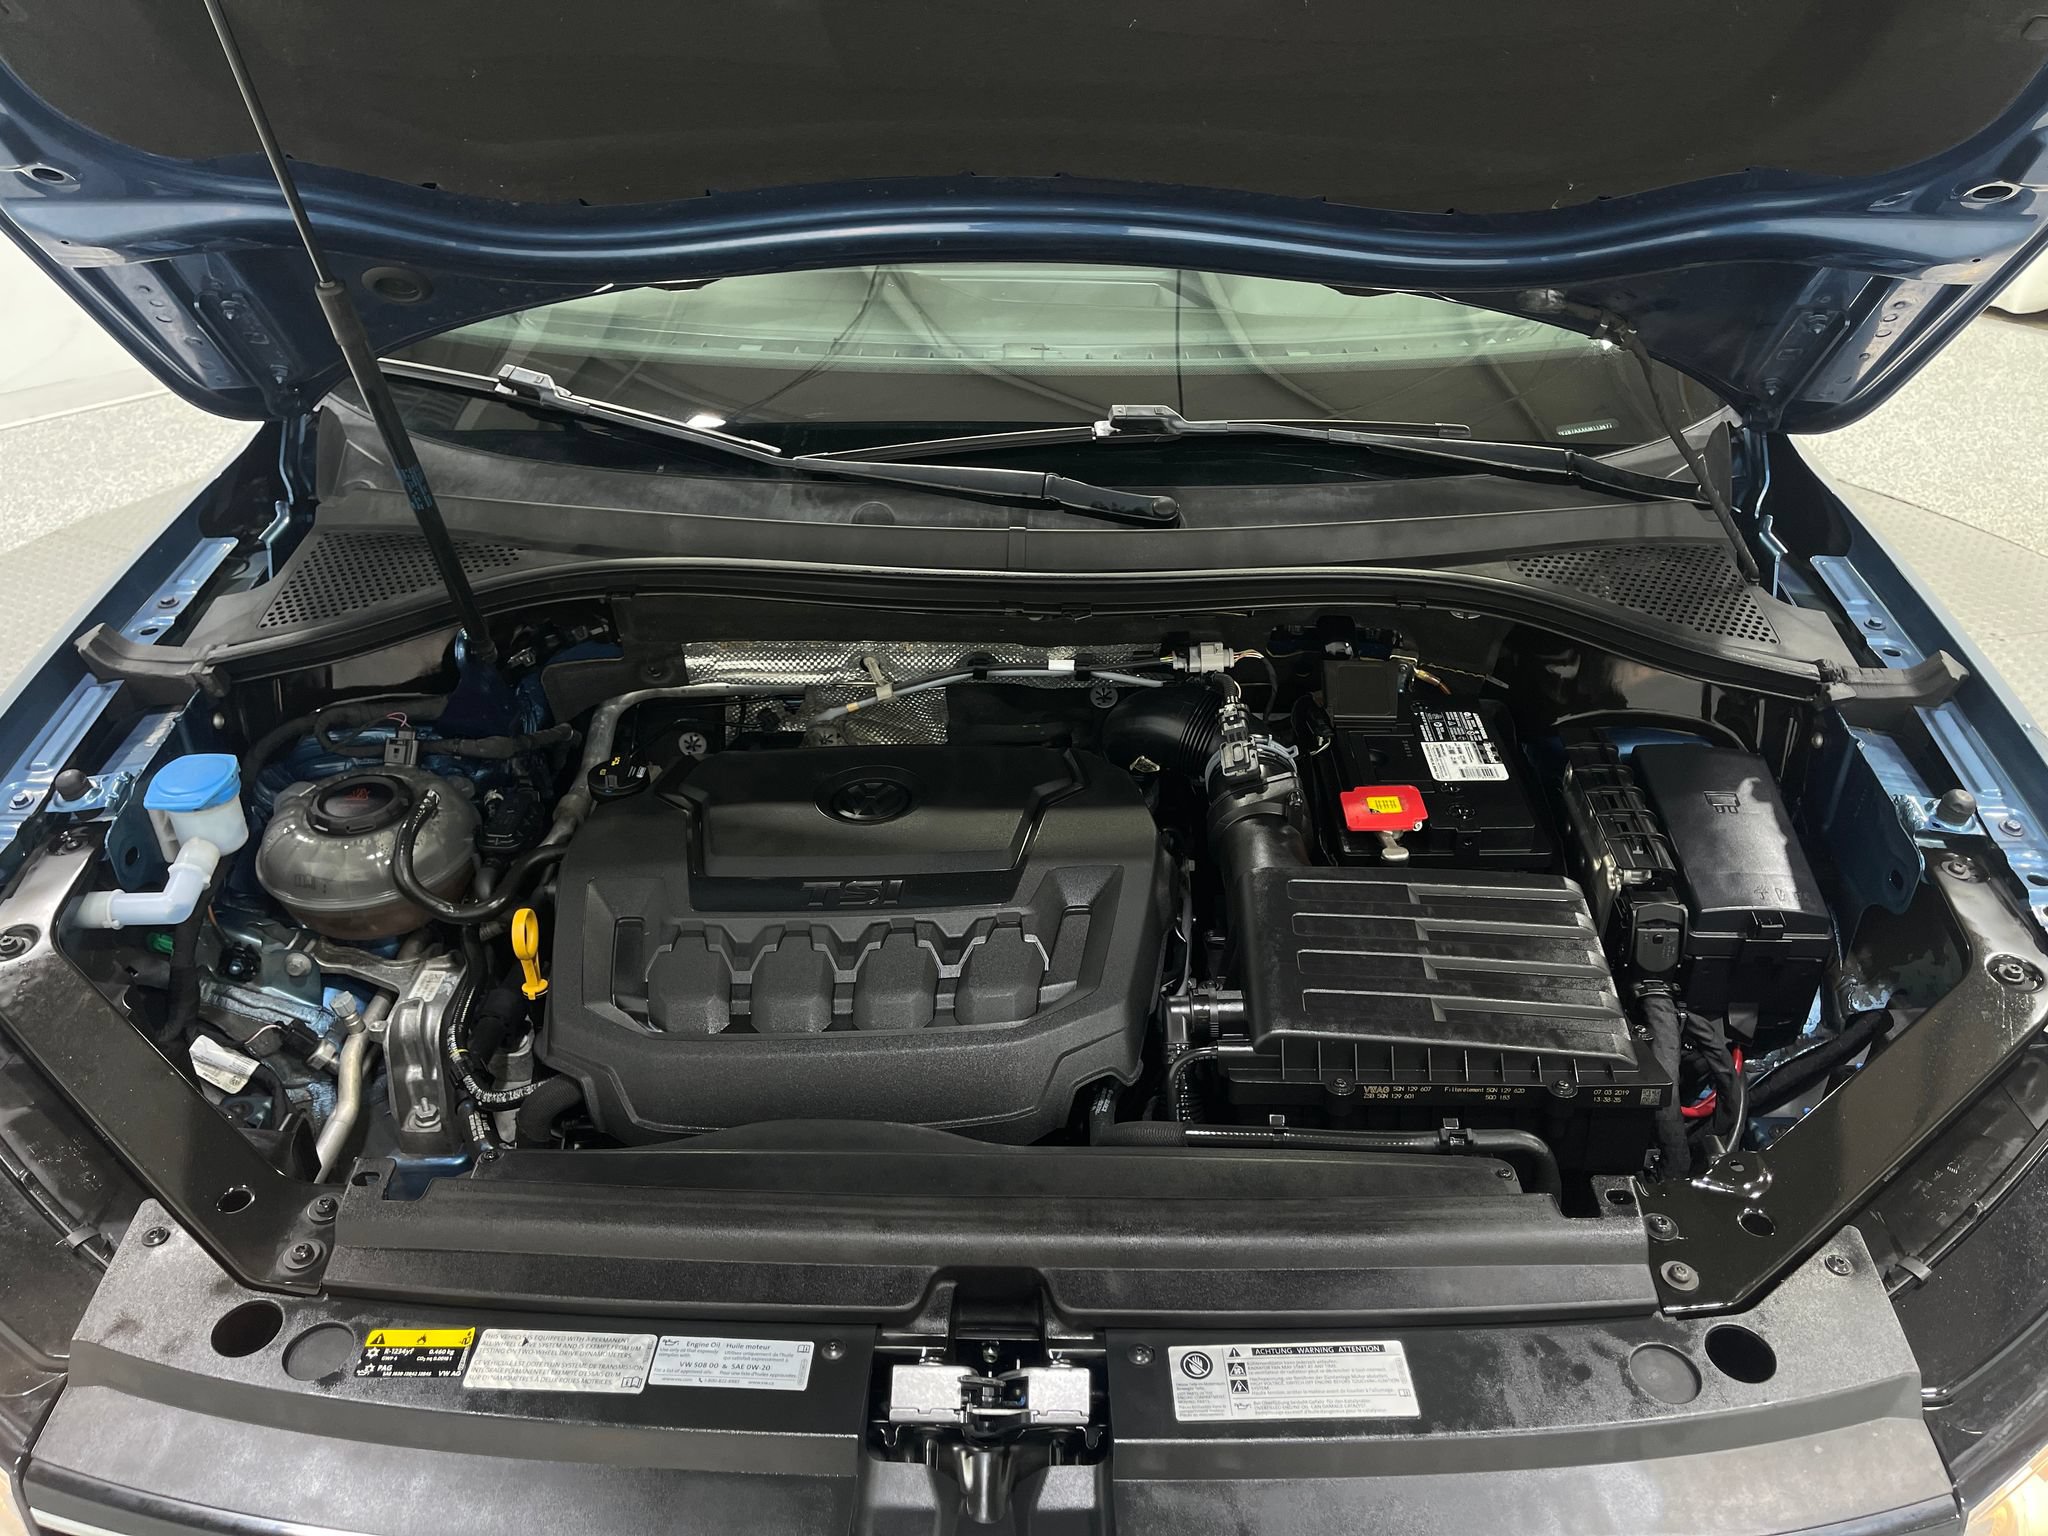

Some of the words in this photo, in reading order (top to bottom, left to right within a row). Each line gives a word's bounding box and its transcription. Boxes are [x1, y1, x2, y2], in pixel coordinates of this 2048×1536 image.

[801, 880, 904, 906] TSI
[384, 1348, 415, 1356] R-1234yf
[1338, 1345, 1380, 1353] ATTENTION
